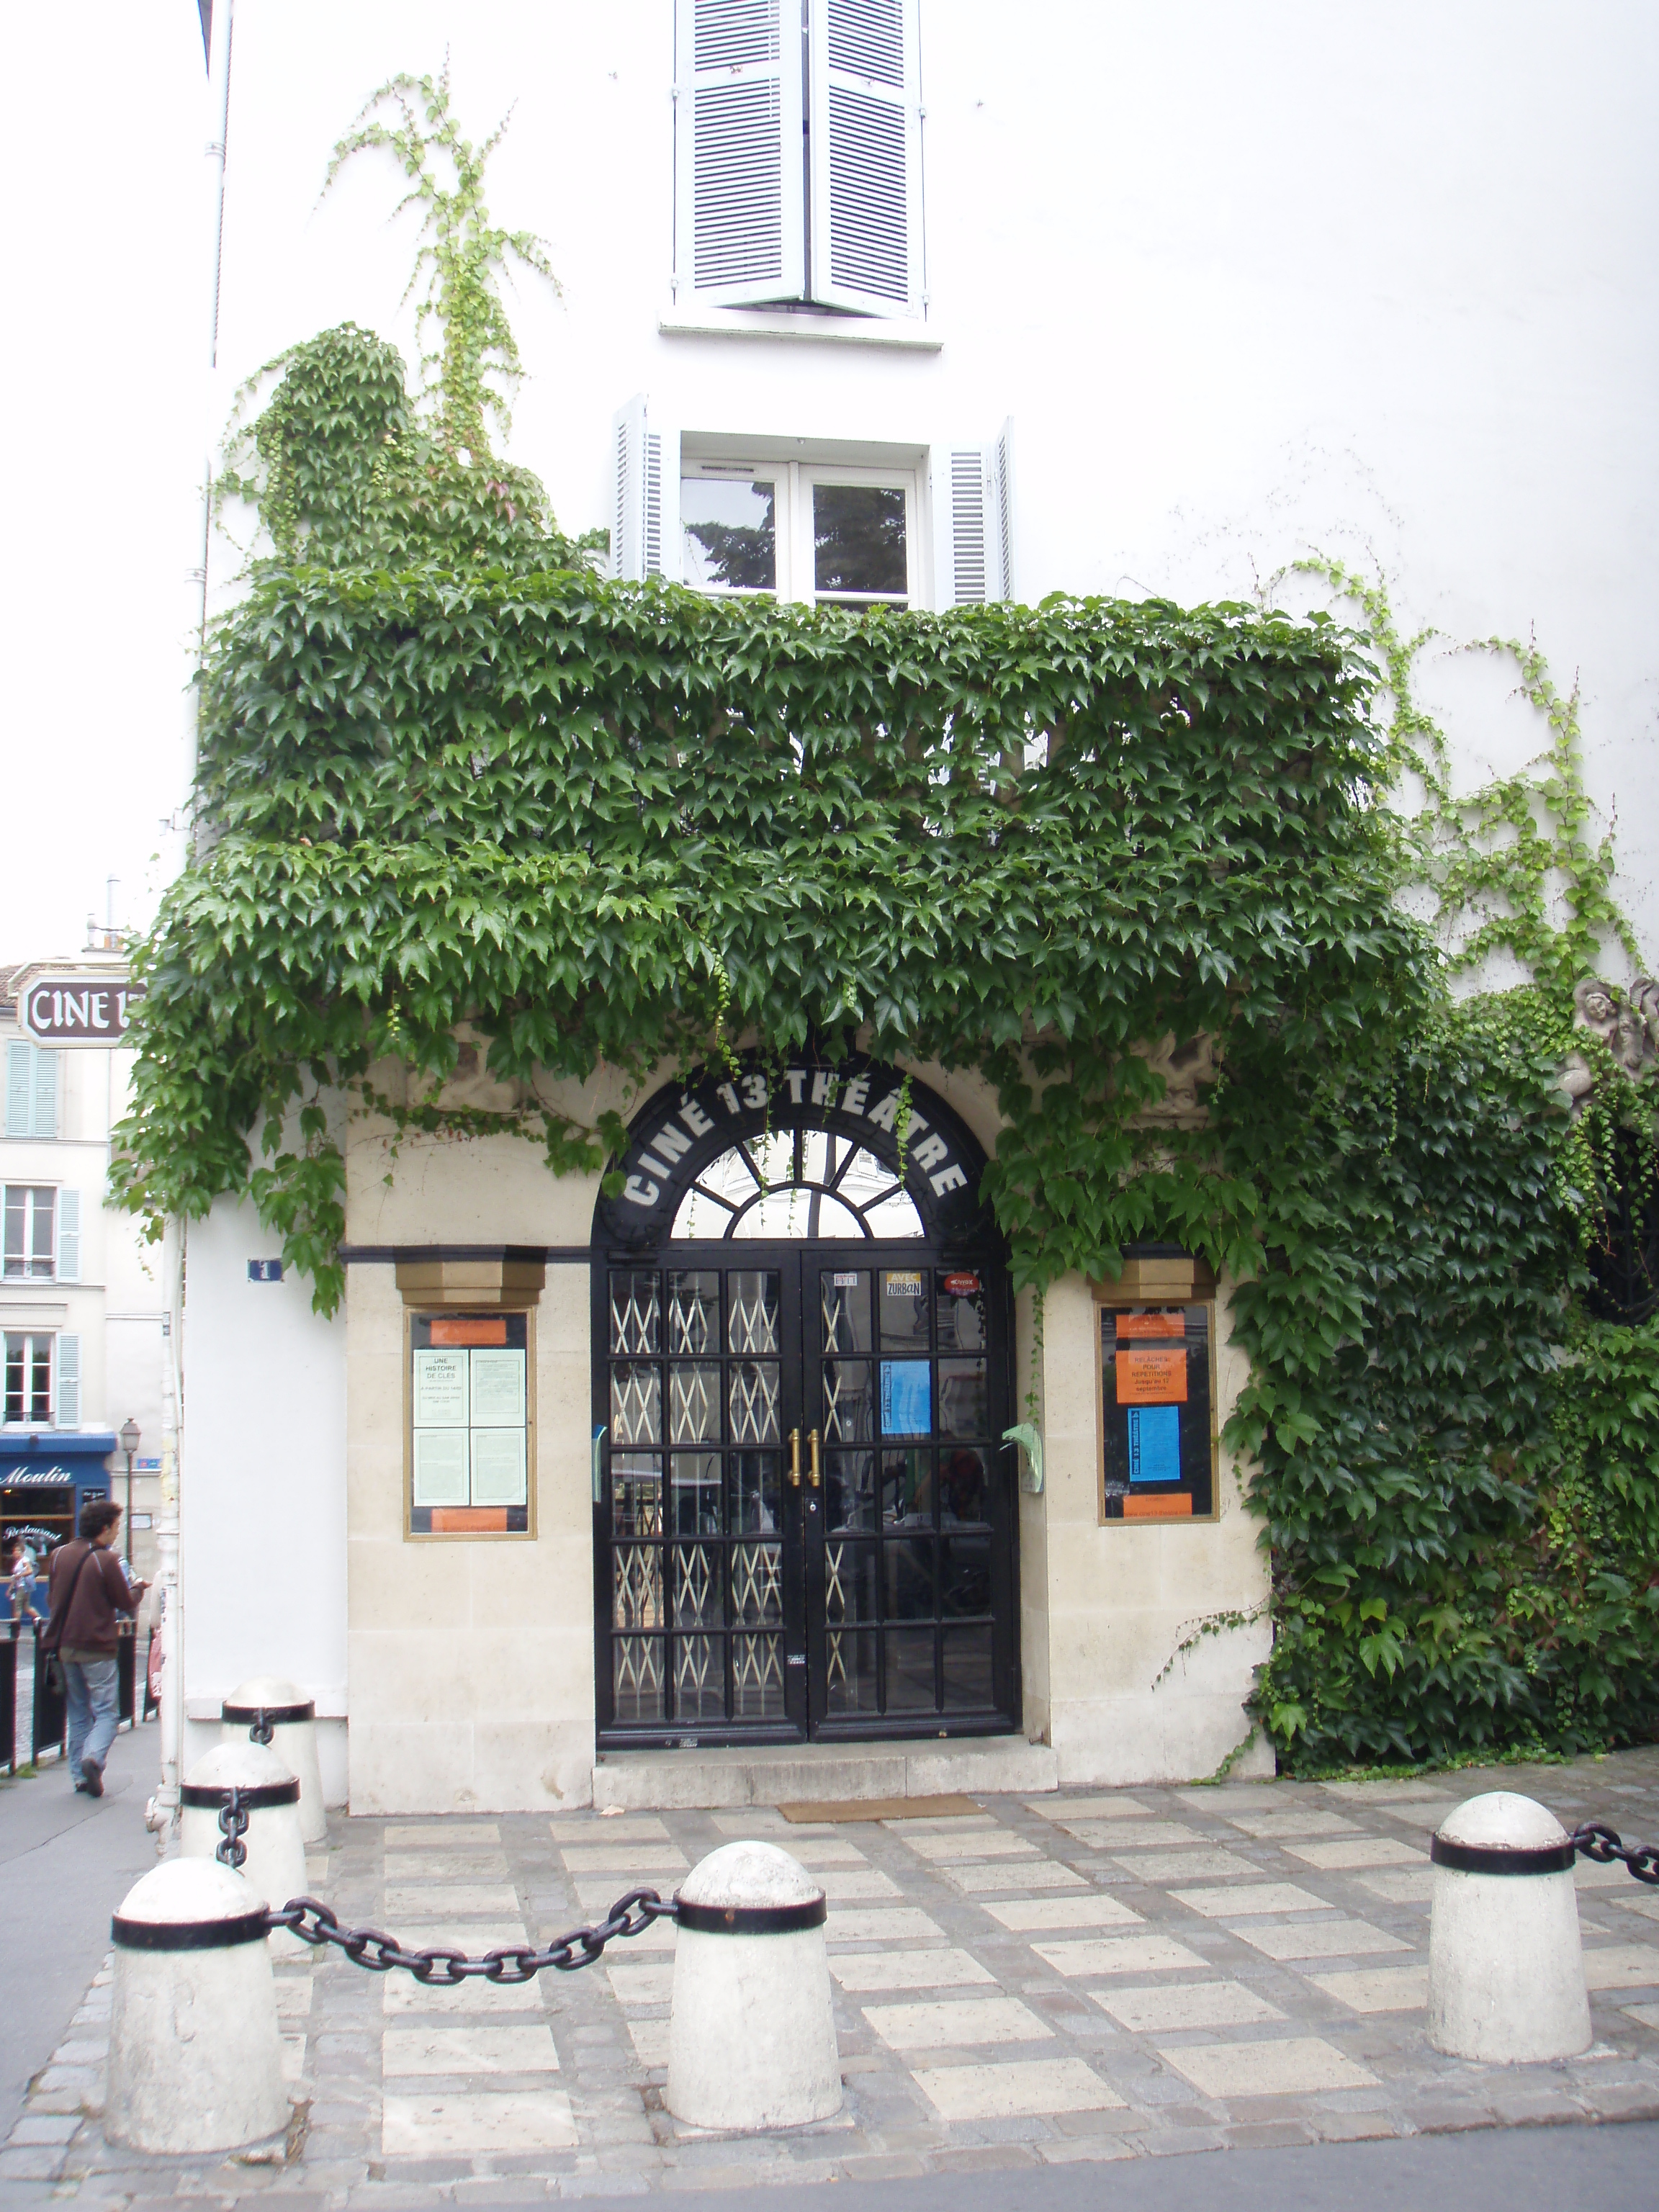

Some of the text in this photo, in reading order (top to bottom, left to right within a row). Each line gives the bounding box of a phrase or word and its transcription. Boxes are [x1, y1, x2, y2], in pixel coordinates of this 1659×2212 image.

[32, 990, 109, 1029] CINE
[624, 1069, 968, 1207] CINÉ 13 THÉÂTRE
[260, 1262, 269, 1280] 1
[0, 1466, 72, 1484] Moulin
[3, 1524, 63, 1541] Restaurant
